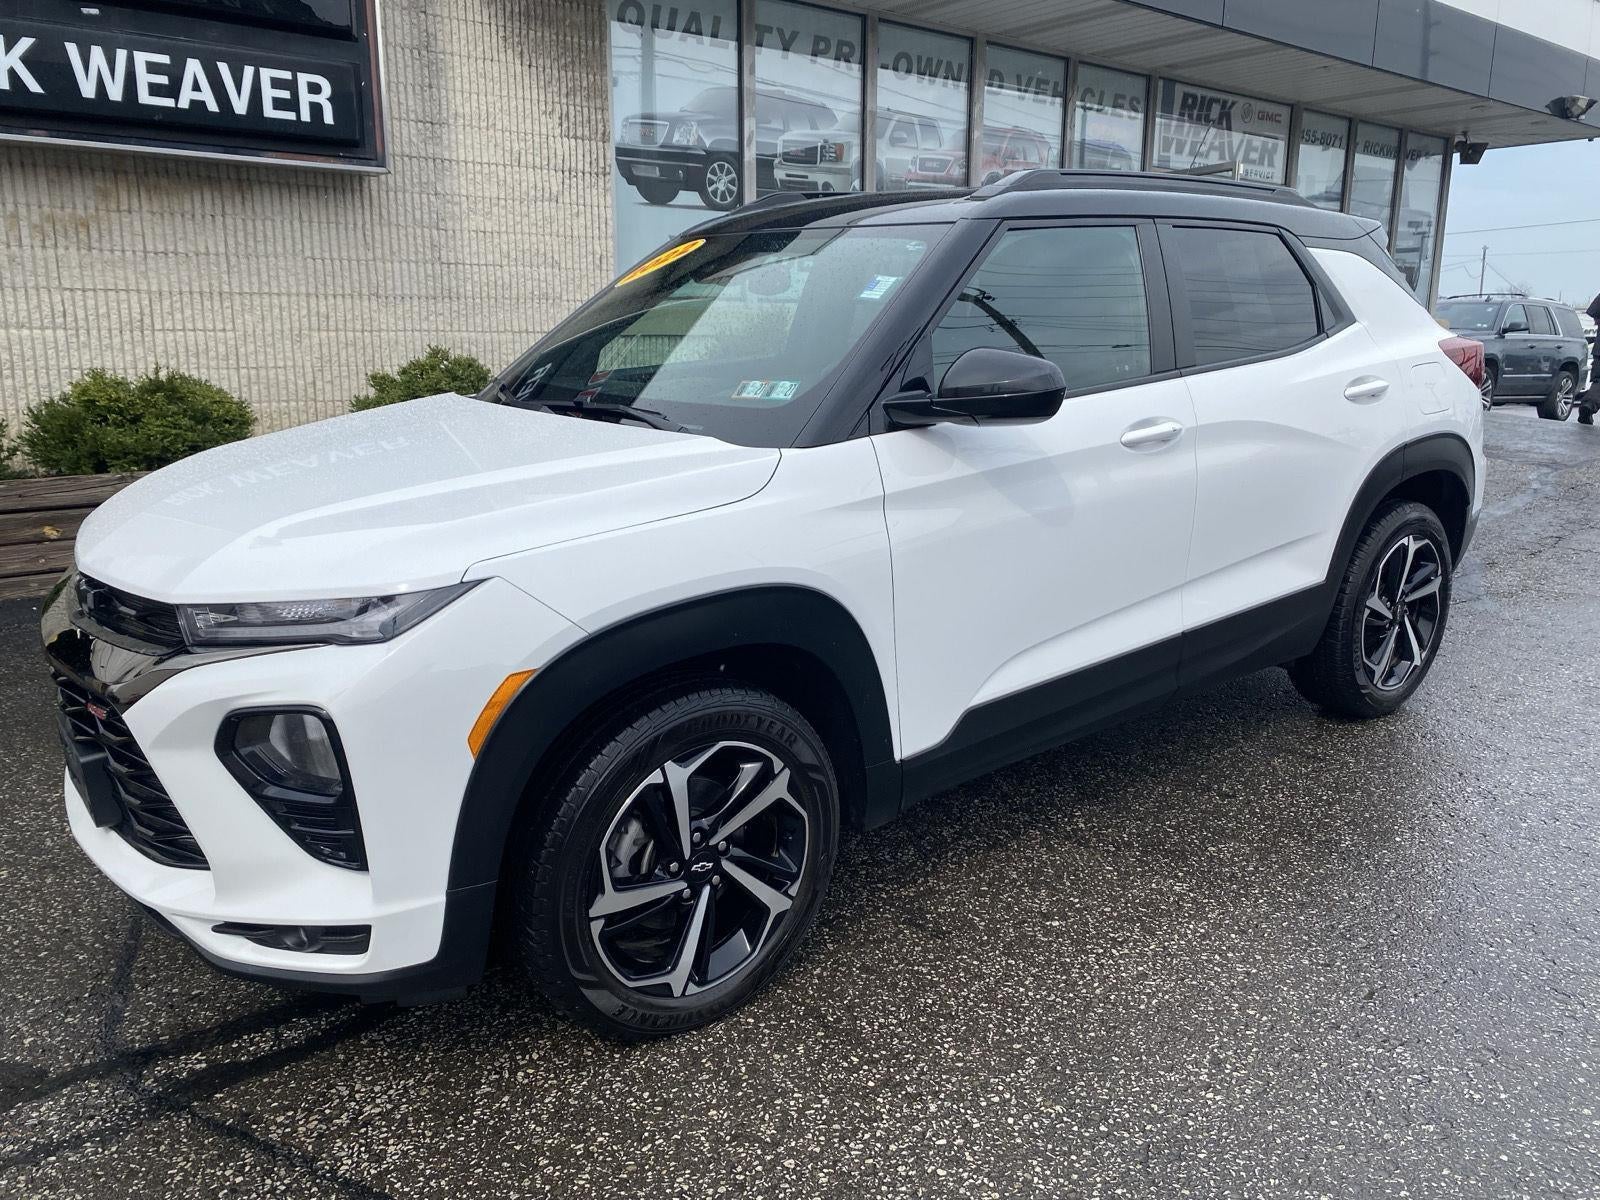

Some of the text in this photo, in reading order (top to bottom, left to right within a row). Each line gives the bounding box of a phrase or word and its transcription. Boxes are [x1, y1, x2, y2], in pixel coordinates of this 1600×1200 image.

[64, 41, 335, 125] WEAVER
[616, 0, 1143, 120] QUALTY PR-OWND VEHCLES
[1178, 91, 1238, 131] RICK
[1257, 111, 1283, 123] GMC
[1160, 122, 1279, 168] WEAVER
